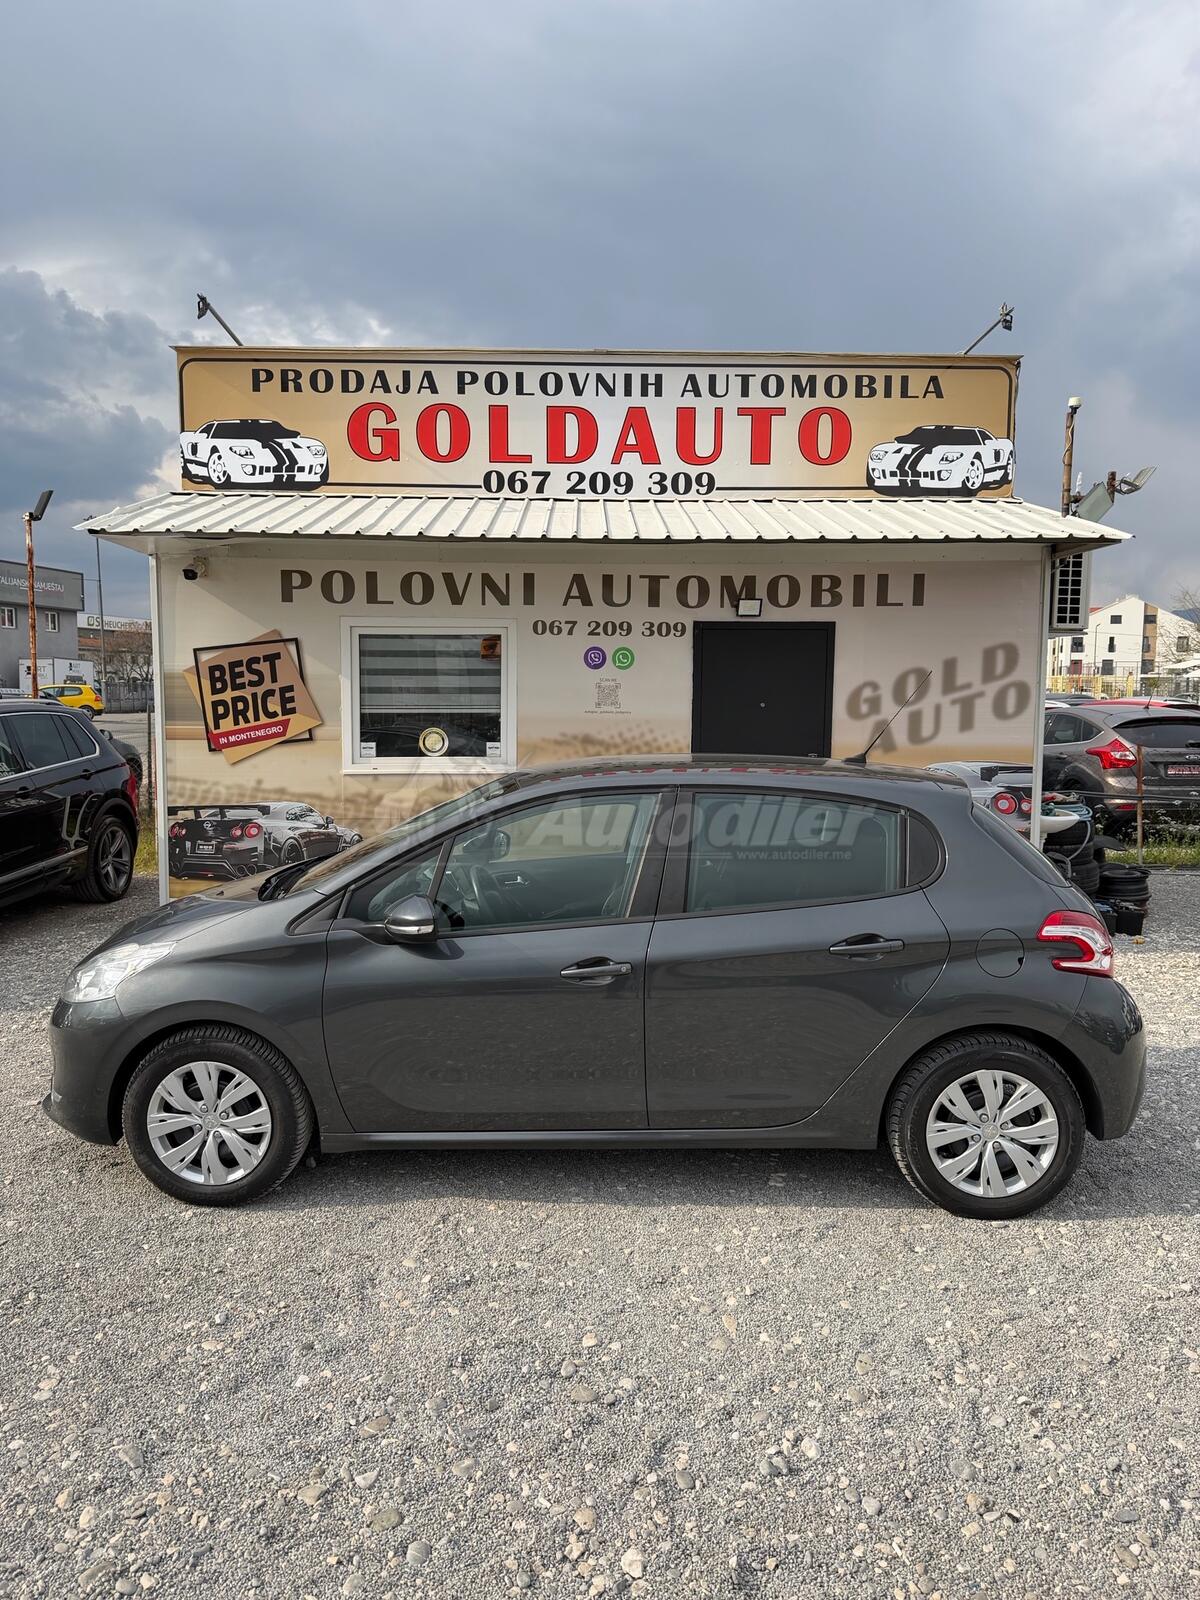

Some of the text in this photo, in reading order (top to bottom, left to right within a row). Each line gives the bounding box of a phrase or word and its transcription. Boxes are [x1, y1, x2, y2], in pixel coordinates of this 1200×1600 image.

[251, 367, 944, 399] PRODAJA POLOVNIH AUTOMOBILA
[346, 401, 852, 466] GOLDAUTO
[483, 470, 716, 495] 067 209 309
[280, 569, 925, 609] POLOVNI AUTOMOBILI
[532, 619, 687, 638] 067 209 309
[208, 652, 281, 696] BEST
[845, 641, 1020, 721] GOLD
[211, 684, 297, 730] PRICE
[865, 679, 1031, 754] AUTO
[219, 725, 284, 745] IN MONTENEGRO
